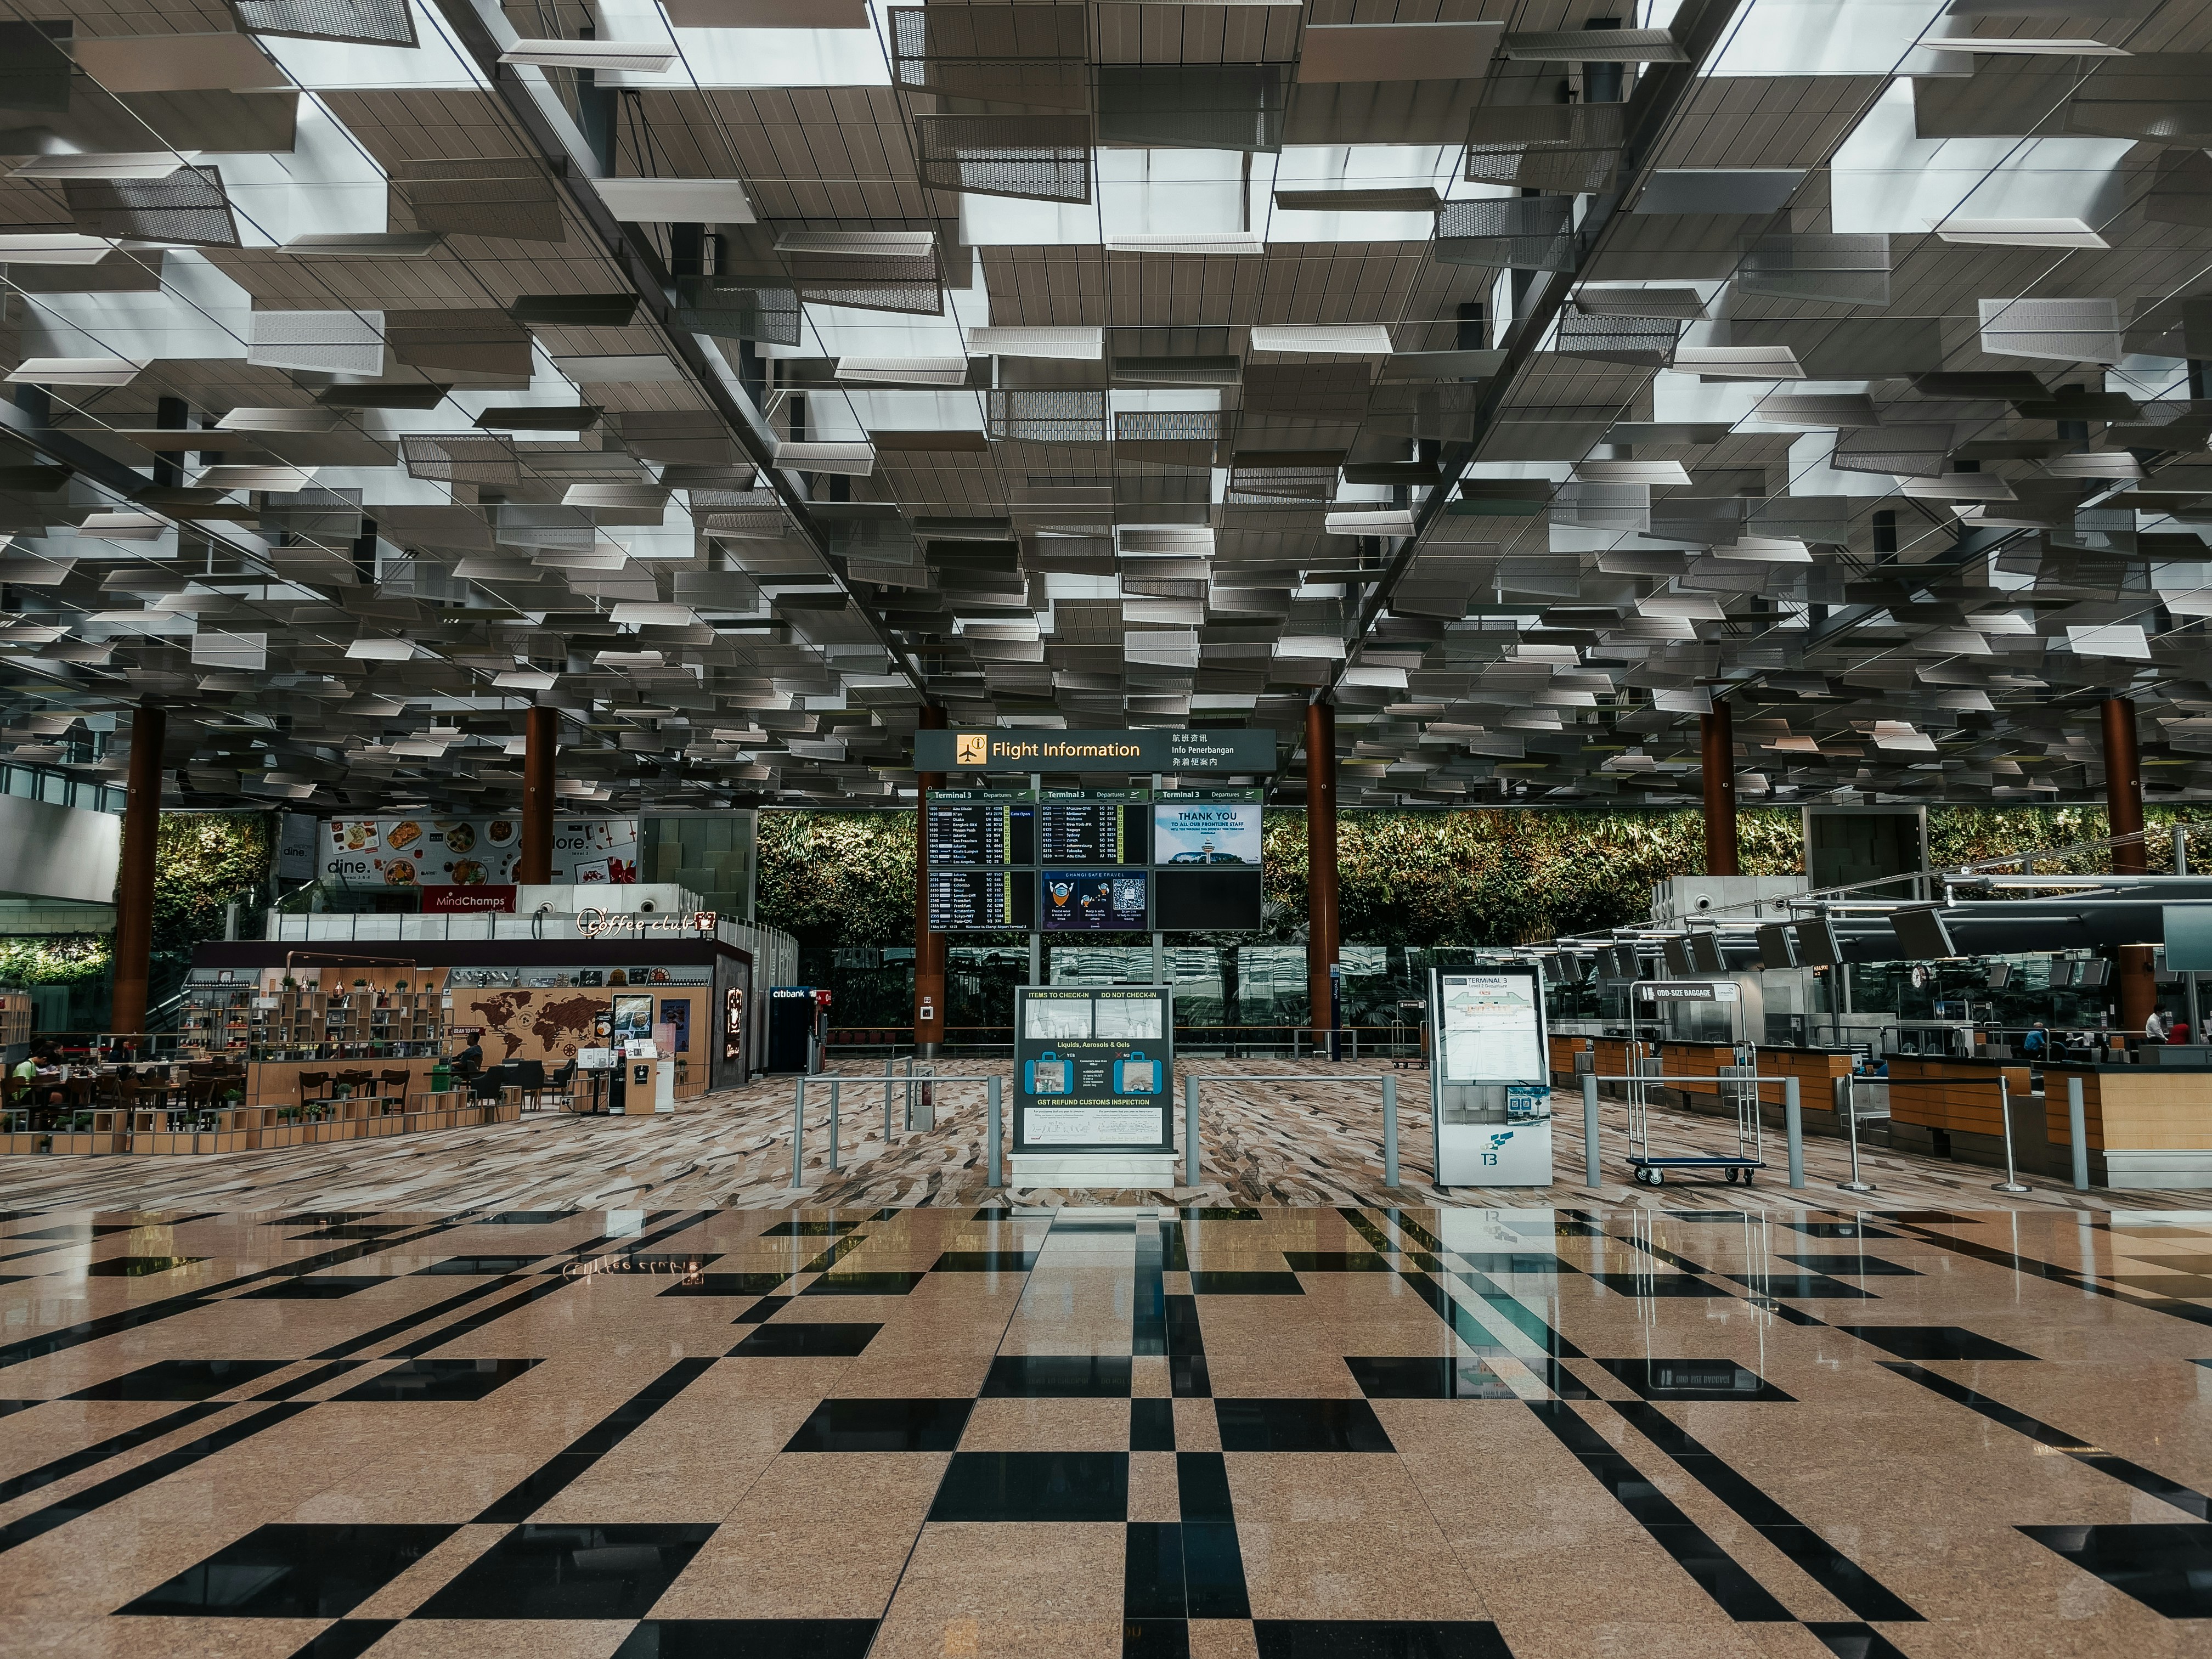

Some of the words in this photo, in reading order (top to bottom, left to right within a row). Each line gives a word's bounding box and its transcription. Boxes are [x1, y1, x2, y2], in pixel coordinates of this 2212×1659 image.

[1172, 733, 1207, 742] 航班资讯
[992, 742, 1039, 760] Flight
[1043, 742, 1141, 757] Information
[1188, 746, 1234, 755] Penerbangan
[1178, 812, 1213, 820] THANK
[1216, 812, 1237, 820] YOU
[517, 835, 589, 849] lore.
[284, 847, 307, 857] dine.
[328, 859, 371, 873] dine.
[437, 892, 505, 907] MindChamps
[652, 915, 695, 931] club
[773, 989, 805, 998] citibank
[1480, 1153, 1498, 1166] T3
